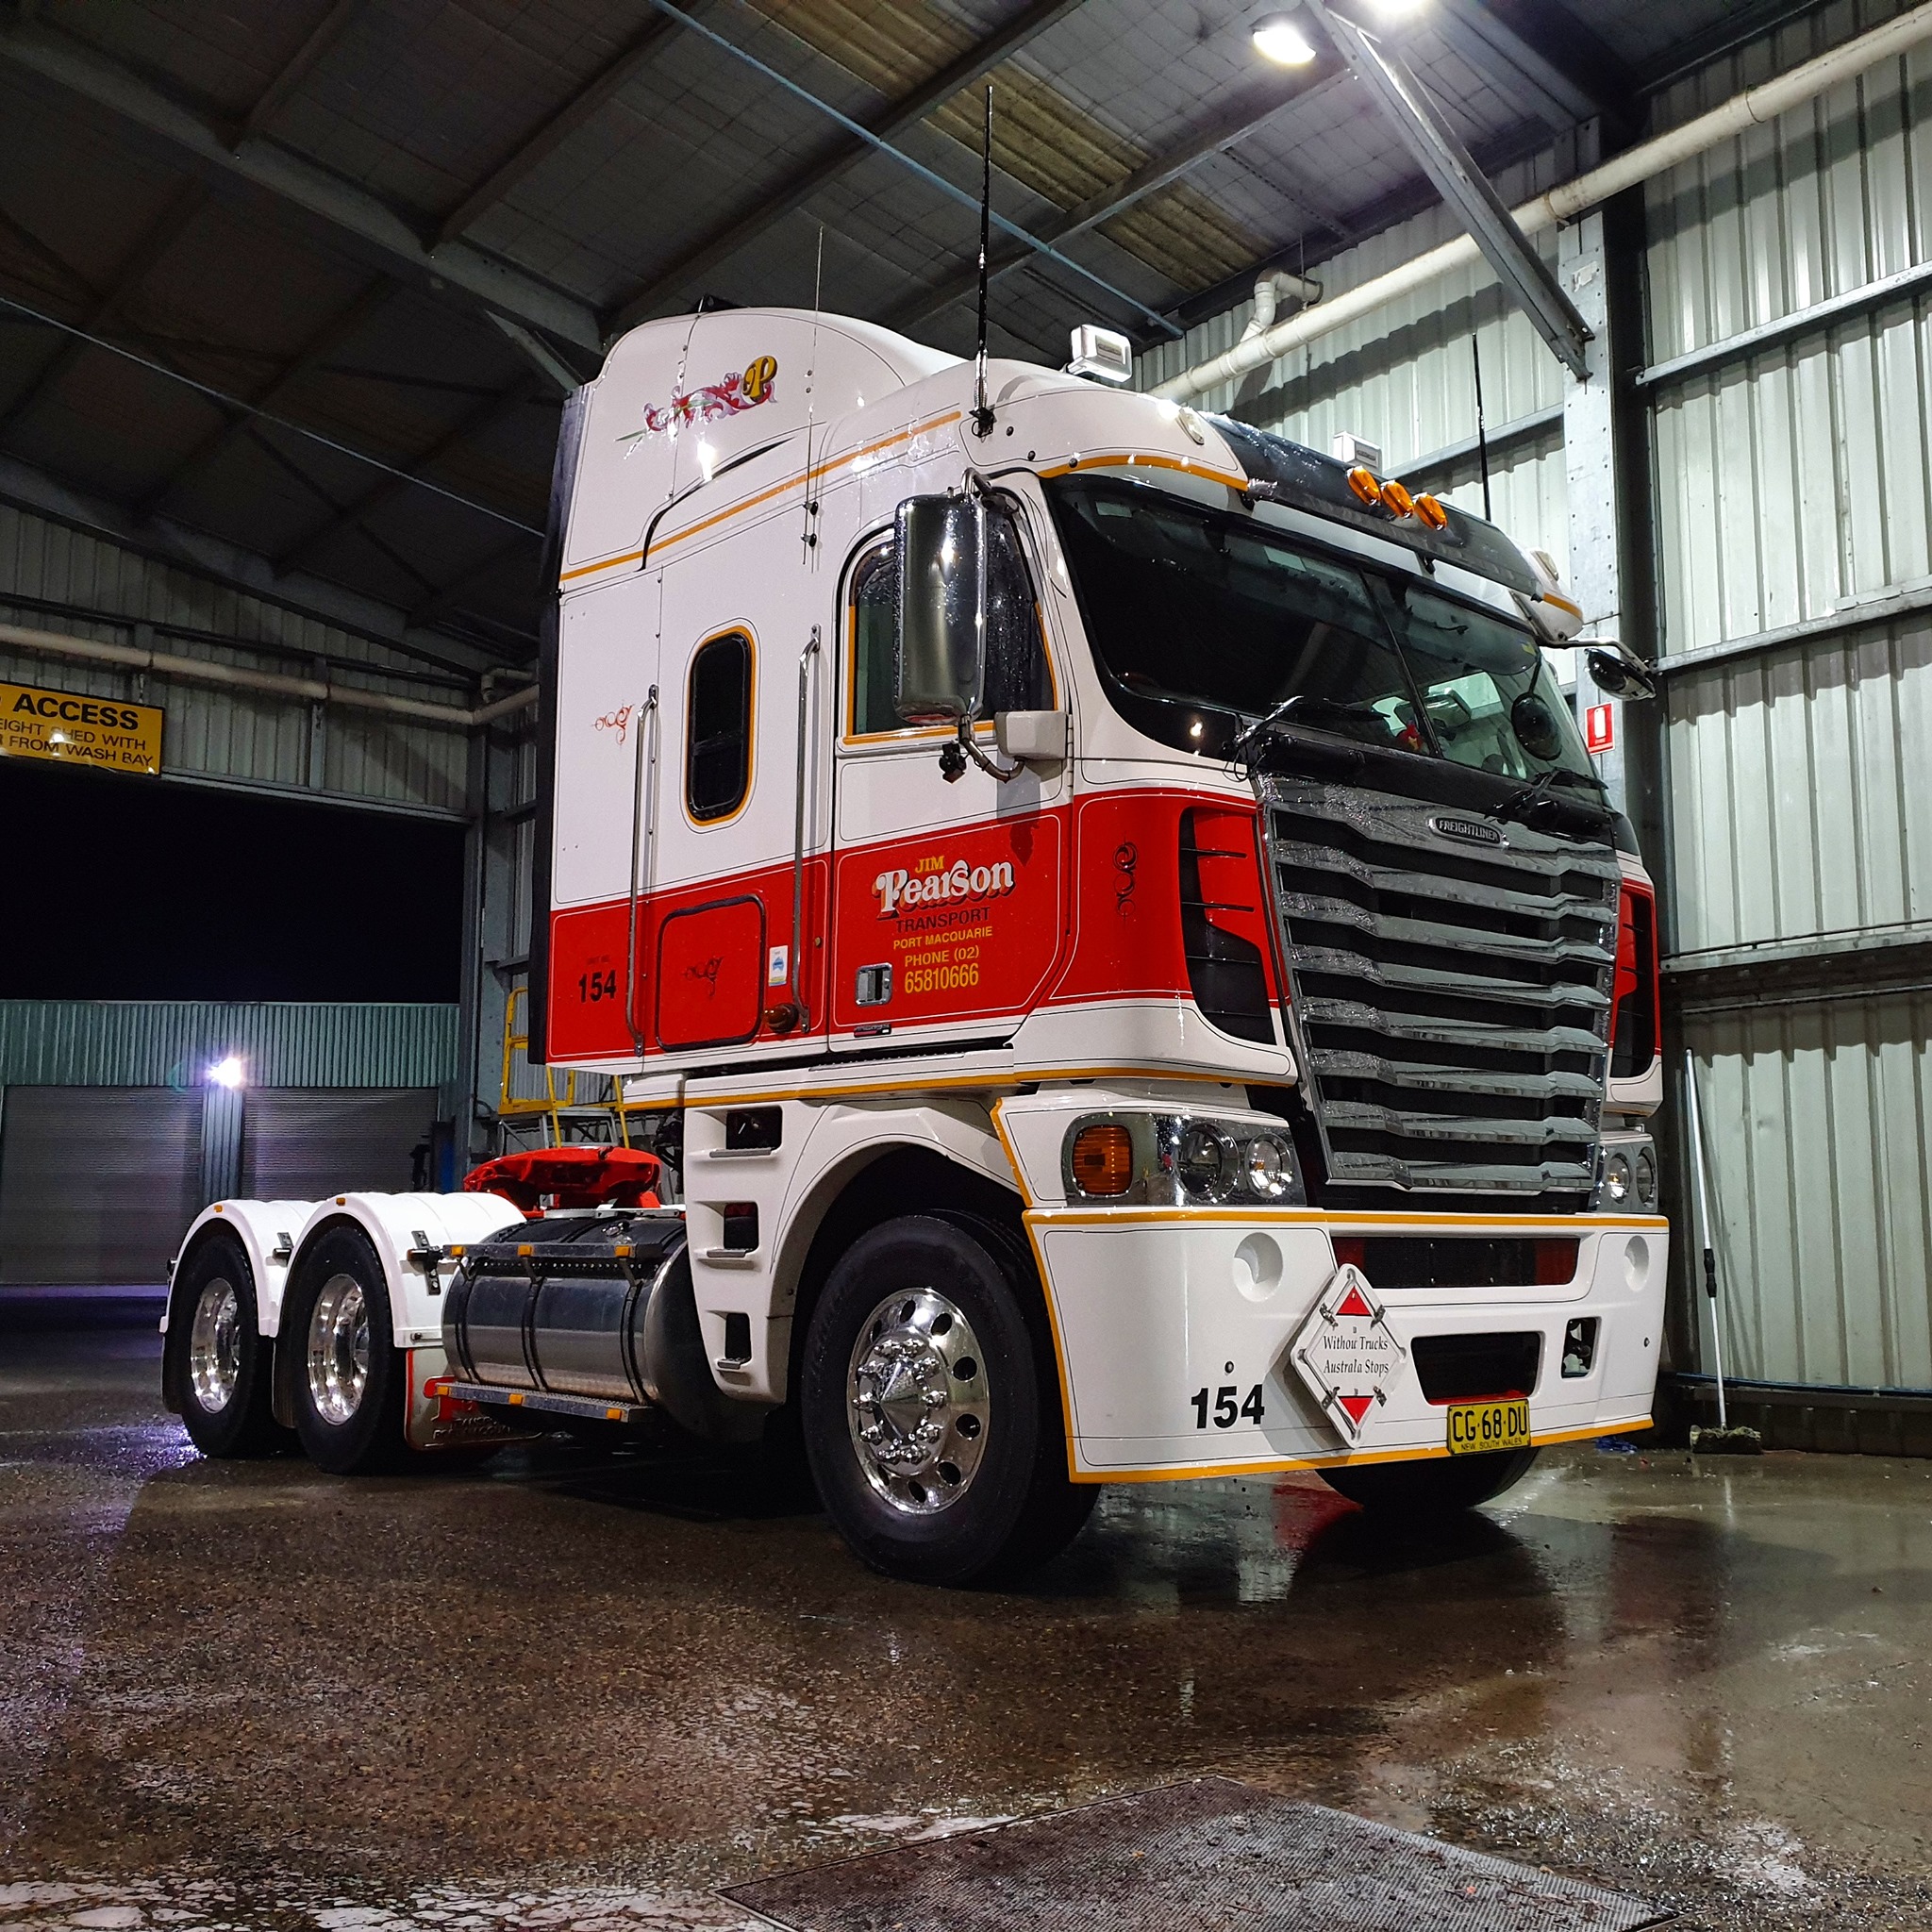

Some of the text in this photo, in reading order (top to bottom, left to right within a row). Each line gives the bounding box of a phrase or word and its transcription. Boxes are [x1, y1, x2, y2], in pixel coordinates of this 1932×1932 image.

[12, 693, 139, 730] ACCESS
[51, 725, 95, 743] HED
[102, 734, 146, 751] WITH
[9, 736, 59, 753] FROM
[66, 743, 117, 761] WASH
[122, 752, 154, 767] BAY
[1439, 820, 1499, 841] FREIGHTLINER
[915, 856, 944, 874] JIM
[874, 859, 1015, 916] Pearson
[896, 907, 991, 933] TRANSPORT
[893, 926, 993, 950] PORT MACQUARIE
[905, 945, 980, 967] PHONE (02)
[578, 970, 617, 1003] 154
[905, 963, 979, 993] 65810666
[1359, 1336, 1389, 1350] Trucks
[1365, 1358, 1389, 1377] Stops
[1191, 1384, 1265, 1428] 154
[1479, 1440, 1500, 1449] SOUTH
[1502, 1437, 1523, 1446] WALES
